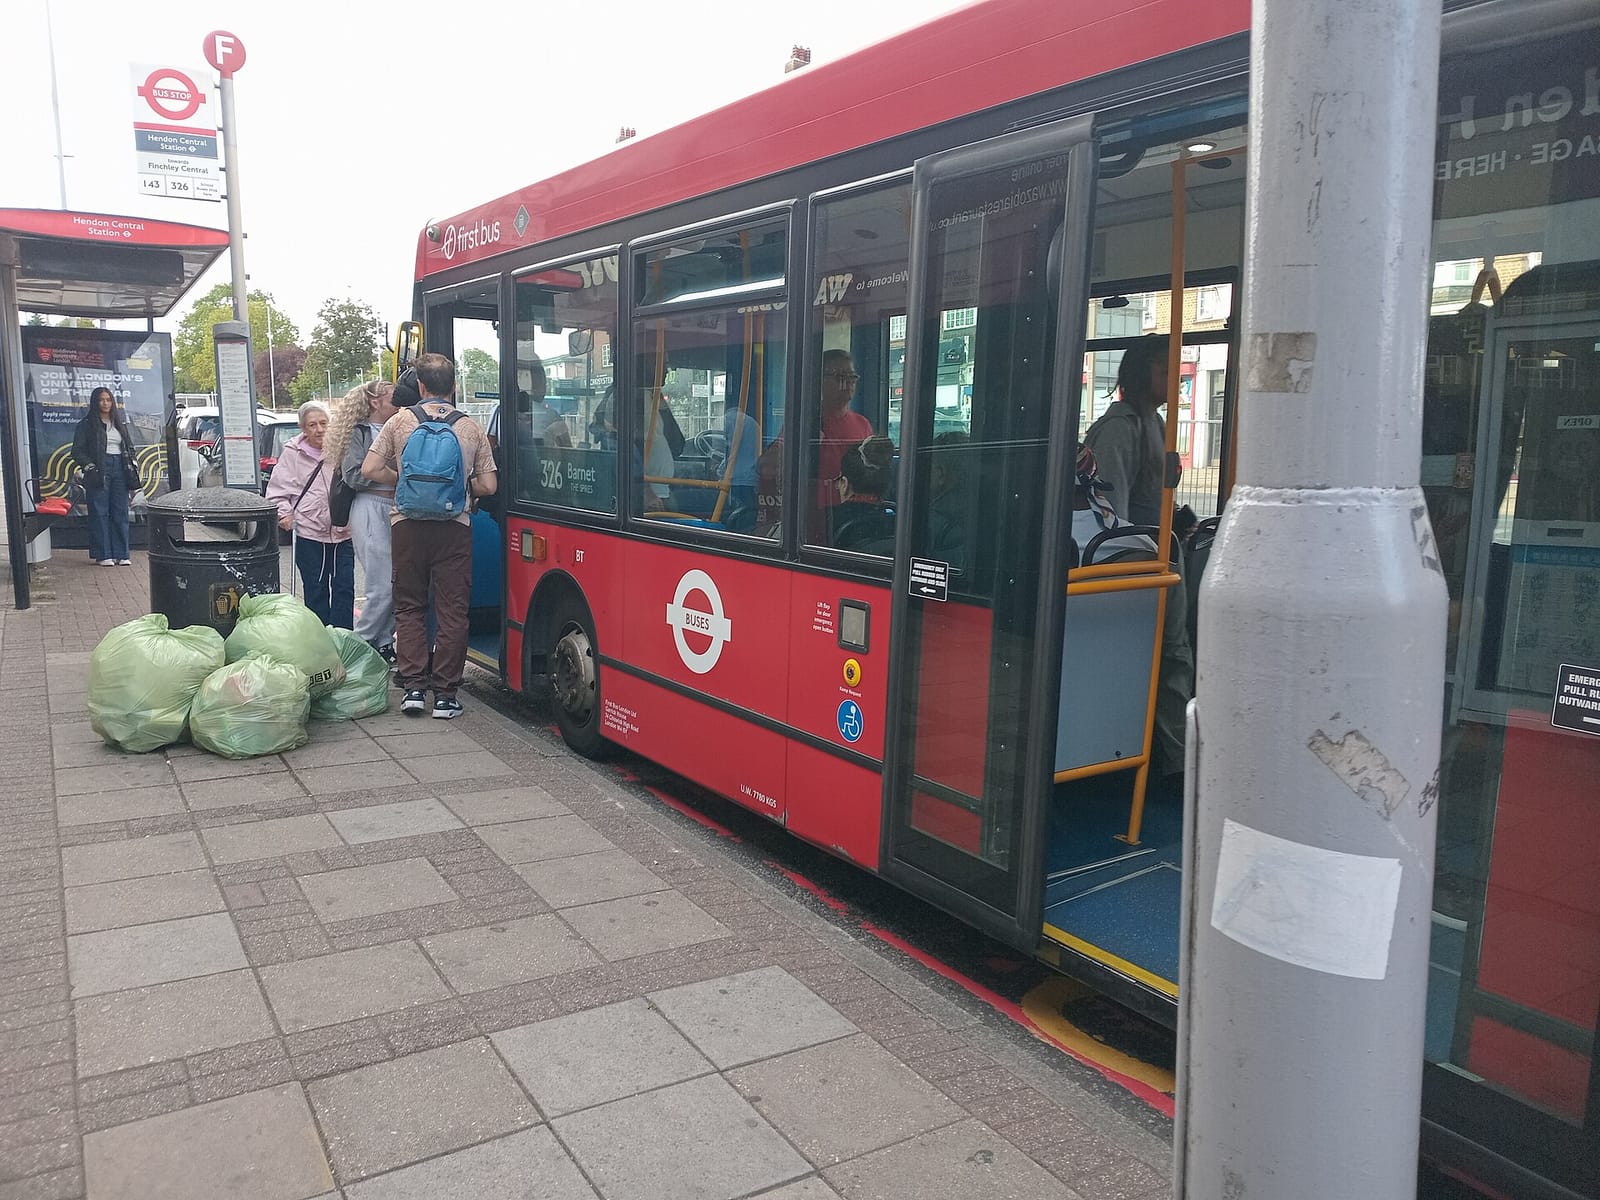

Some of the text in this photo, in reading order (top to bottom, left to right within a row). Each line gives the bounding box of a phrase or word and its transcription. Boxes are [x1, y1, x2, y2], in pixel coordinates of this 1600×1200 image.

[215, 34, 234, 65] F
[152, 89, 192, 100] BUS STOP
[147, 134, 207, 147] Hendon Central
[160, 142, 187, 152] Station
[148, 162, 209, 175] Finchley Central
[143, 179, 189, 191] 143 326
[73, 216, 145, 231] Hendon Central
[88, 227, 120, 237] Station
[40, 371, 144, 382] JOIN LONDON'S
[40, 380, 122, 390] UNIVERSITY
[41, 388, 59, 396] OF
[63, 388, 92, 397] THE
[541, 459, 596, 490] 326 Barnet
[685, 612, 710, 630] BUSES
[1563, 684, 1587, 696] PULL
